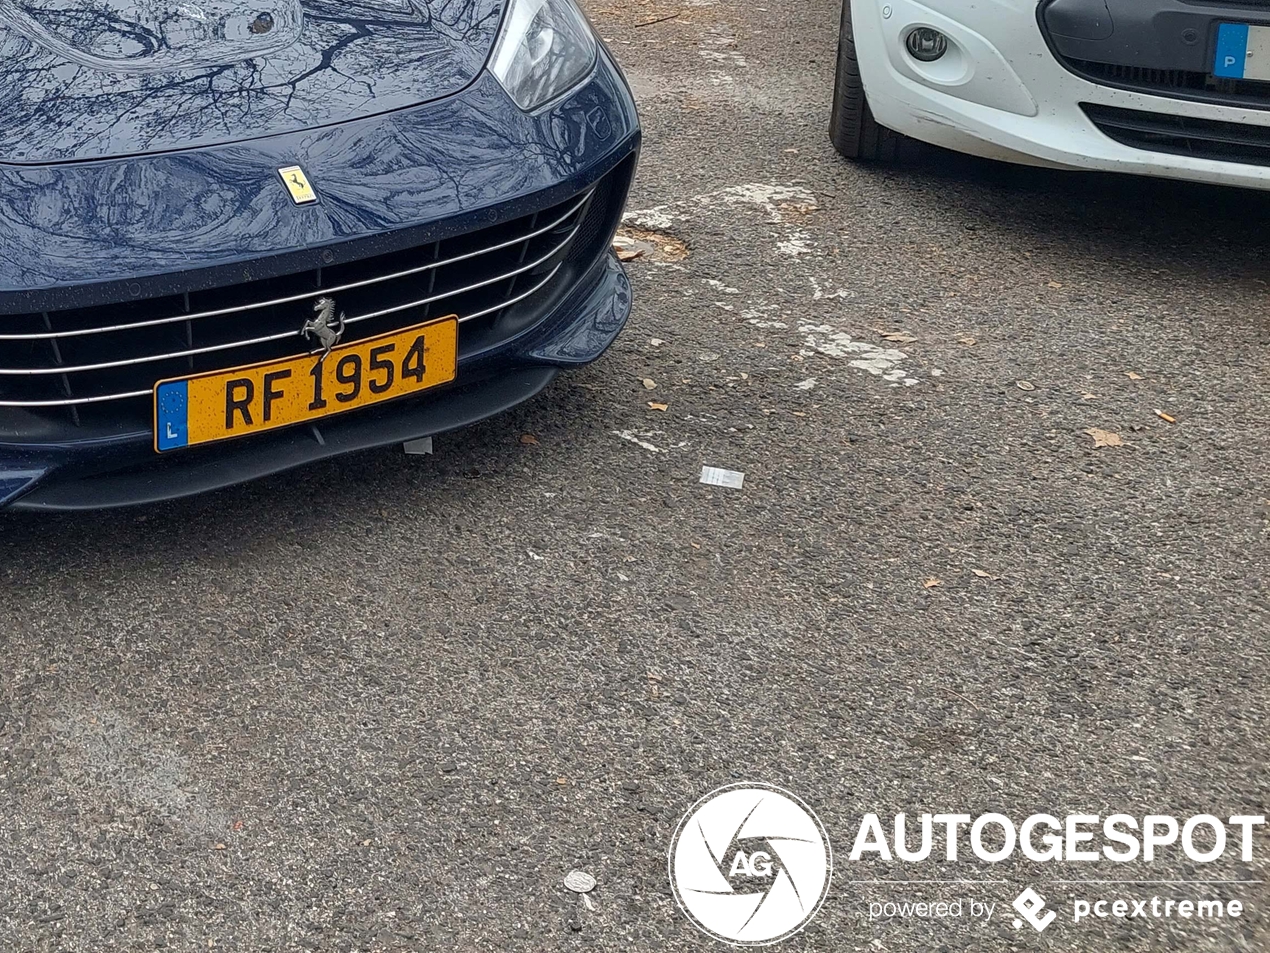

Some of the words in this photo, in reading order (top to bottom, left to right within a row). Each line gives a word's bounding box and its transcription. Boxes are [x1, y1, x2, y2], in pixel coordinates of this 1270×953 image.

[1224, 55, 1236, 68] P
[225, 368, 292, 430] RF
[308, 335, 426, 411] 1954
[167, 422, 178, 439] L
